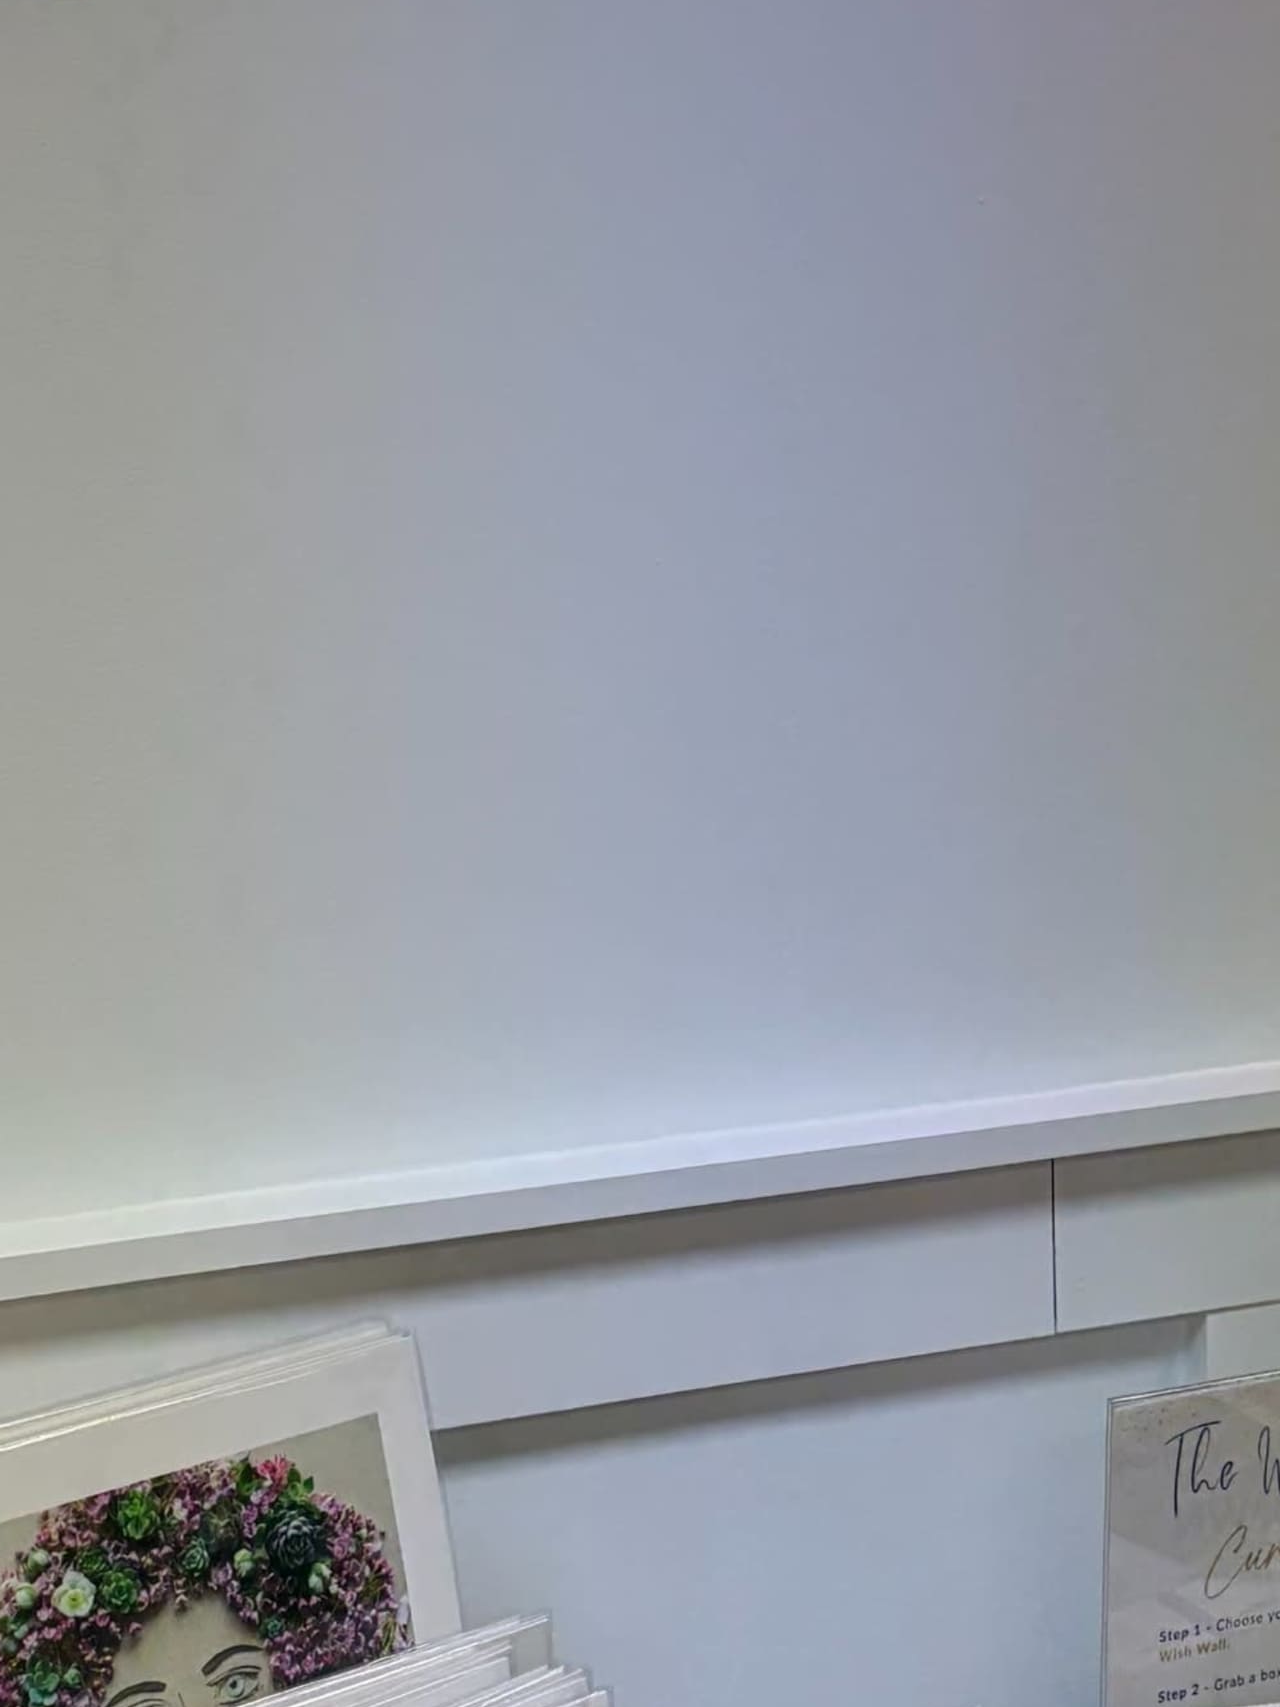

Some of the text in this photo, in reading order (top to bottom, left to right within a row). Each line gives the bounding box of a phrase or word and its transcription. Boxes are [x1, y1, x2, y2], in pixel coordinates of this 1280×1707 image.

[1165, 1419, 1239, 1519] The
[1158, 1627, 1190, 1644] Step
[1194, 1623, 1202, 1637] 1
[1215, 1612, 1264, 1633] Choose
[1159, 1644, 1194, 1664] Wish
[1157, 1686, 1189, 1705] Step
[1191, 1683, 1200, 1697] 2
[1213, 1674, 1246, 1693] Grab
[1248, 1675, 1257, 1686] a
